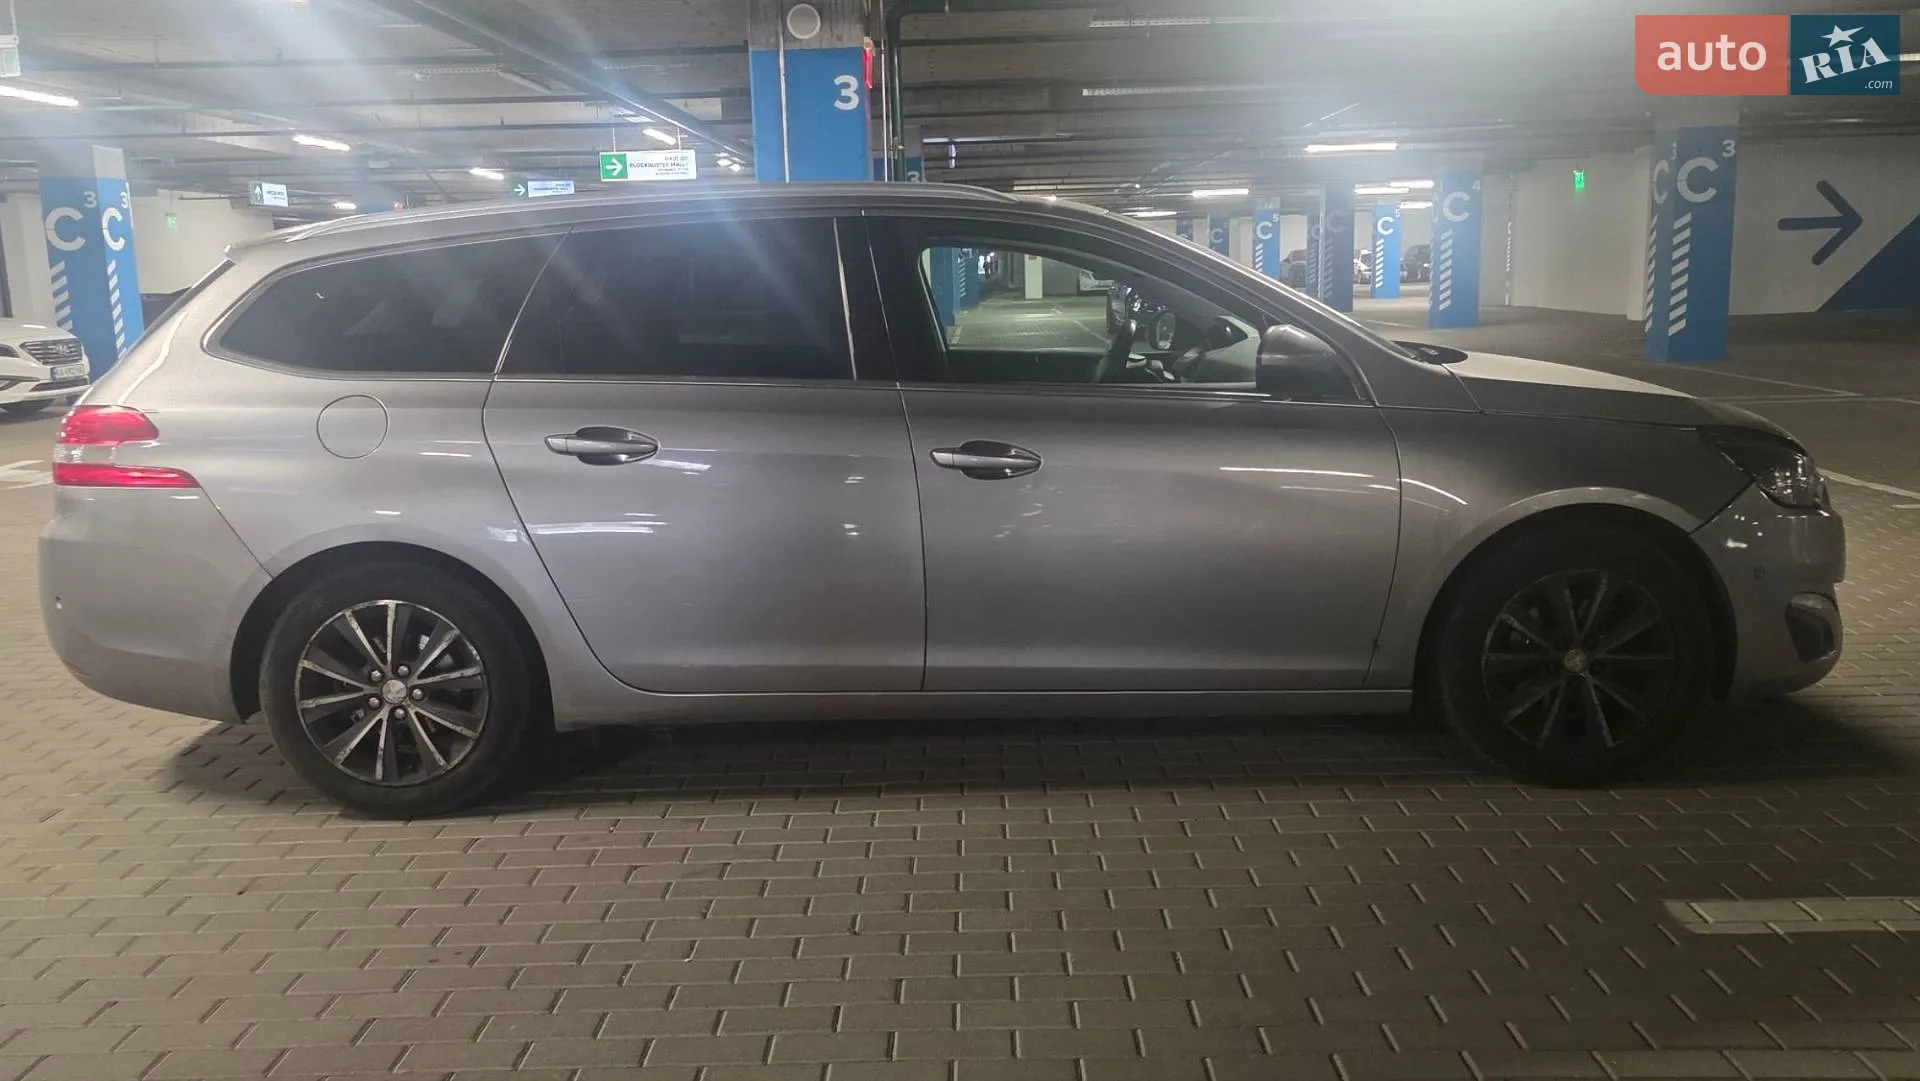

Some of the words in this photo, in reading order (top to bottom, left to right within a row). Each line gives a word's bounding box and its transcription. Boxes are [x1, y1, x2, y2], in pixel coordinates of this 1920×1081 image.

[833, 74, 860, 111] 3
[1677, 156, 1719, 203] C
[1722, 139, 1736, 157] 3
[46, 206, 86, 251] C
[83, 190, 98, 208] 3
[102, 207, 126, 251] C
[119, 191, 128, 208] 3
[1443, 191, 1470, 222] C
[1256, 220, 1273, 240] C
[1377, 216, 1395, 235] C
